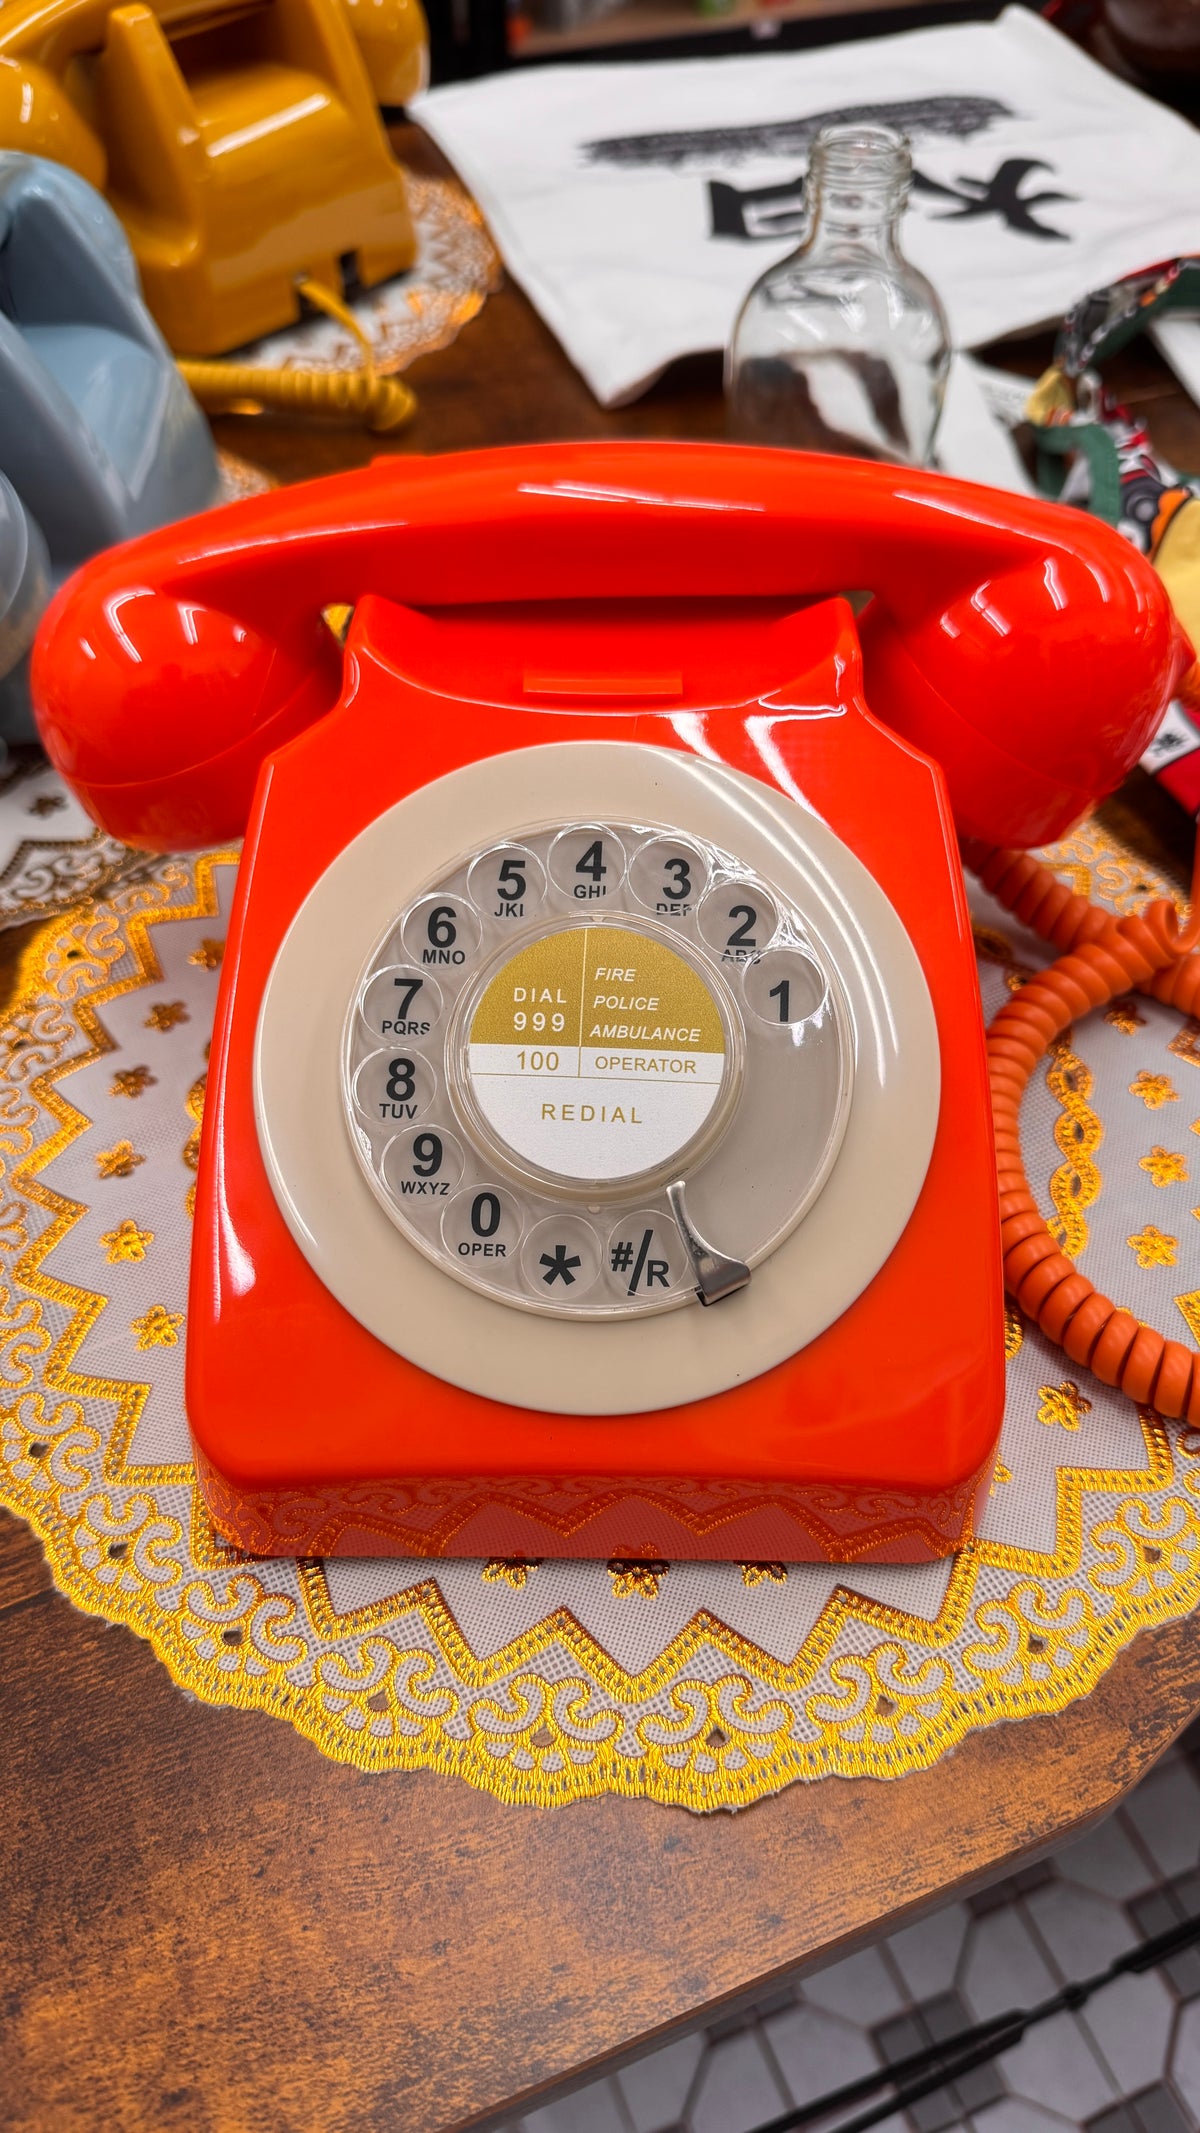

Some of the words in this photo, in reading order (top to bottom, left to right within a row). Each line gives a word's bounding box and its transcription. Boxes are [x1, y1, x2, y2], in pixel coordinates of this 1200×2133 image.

[575, 841, 607, 882] 4
[497, 860, 526, 901] 5
[662, 858, 692, 899] 3
[427, 906, 457, 948] 6
[726, 905, 757, 947] 2
[422, 949, 466, 965] MNO
[594, 967, 637, 982] FIRE
[394, 978, 423, 1020] 7
[513, 987, 567, 1004] DIAL
[593, 995, 659, 1011] POLICE
[769, 980, 790, 1022] 1
[381, 1020, 430, 1035] PQRS
[513, 1012, 565, 1032] 999
[589, 1024, 702, 1042] AMBULANCE
[516, 1051, 559, 1071] 100
[595, 1056, 697, 1074] OPERATOR
[386, 1058, 416, 1101] 8
[379, 1104, 418, 1119] TUV
[541, 1103, 643, 1124] REDIAL
[412, 1133, 443, 1177] 9
[401, 1181, 450, 1196] WXYZ
[471, 1192, 501, 1237] 0
[458, 1242, 506, 1257] OPER
